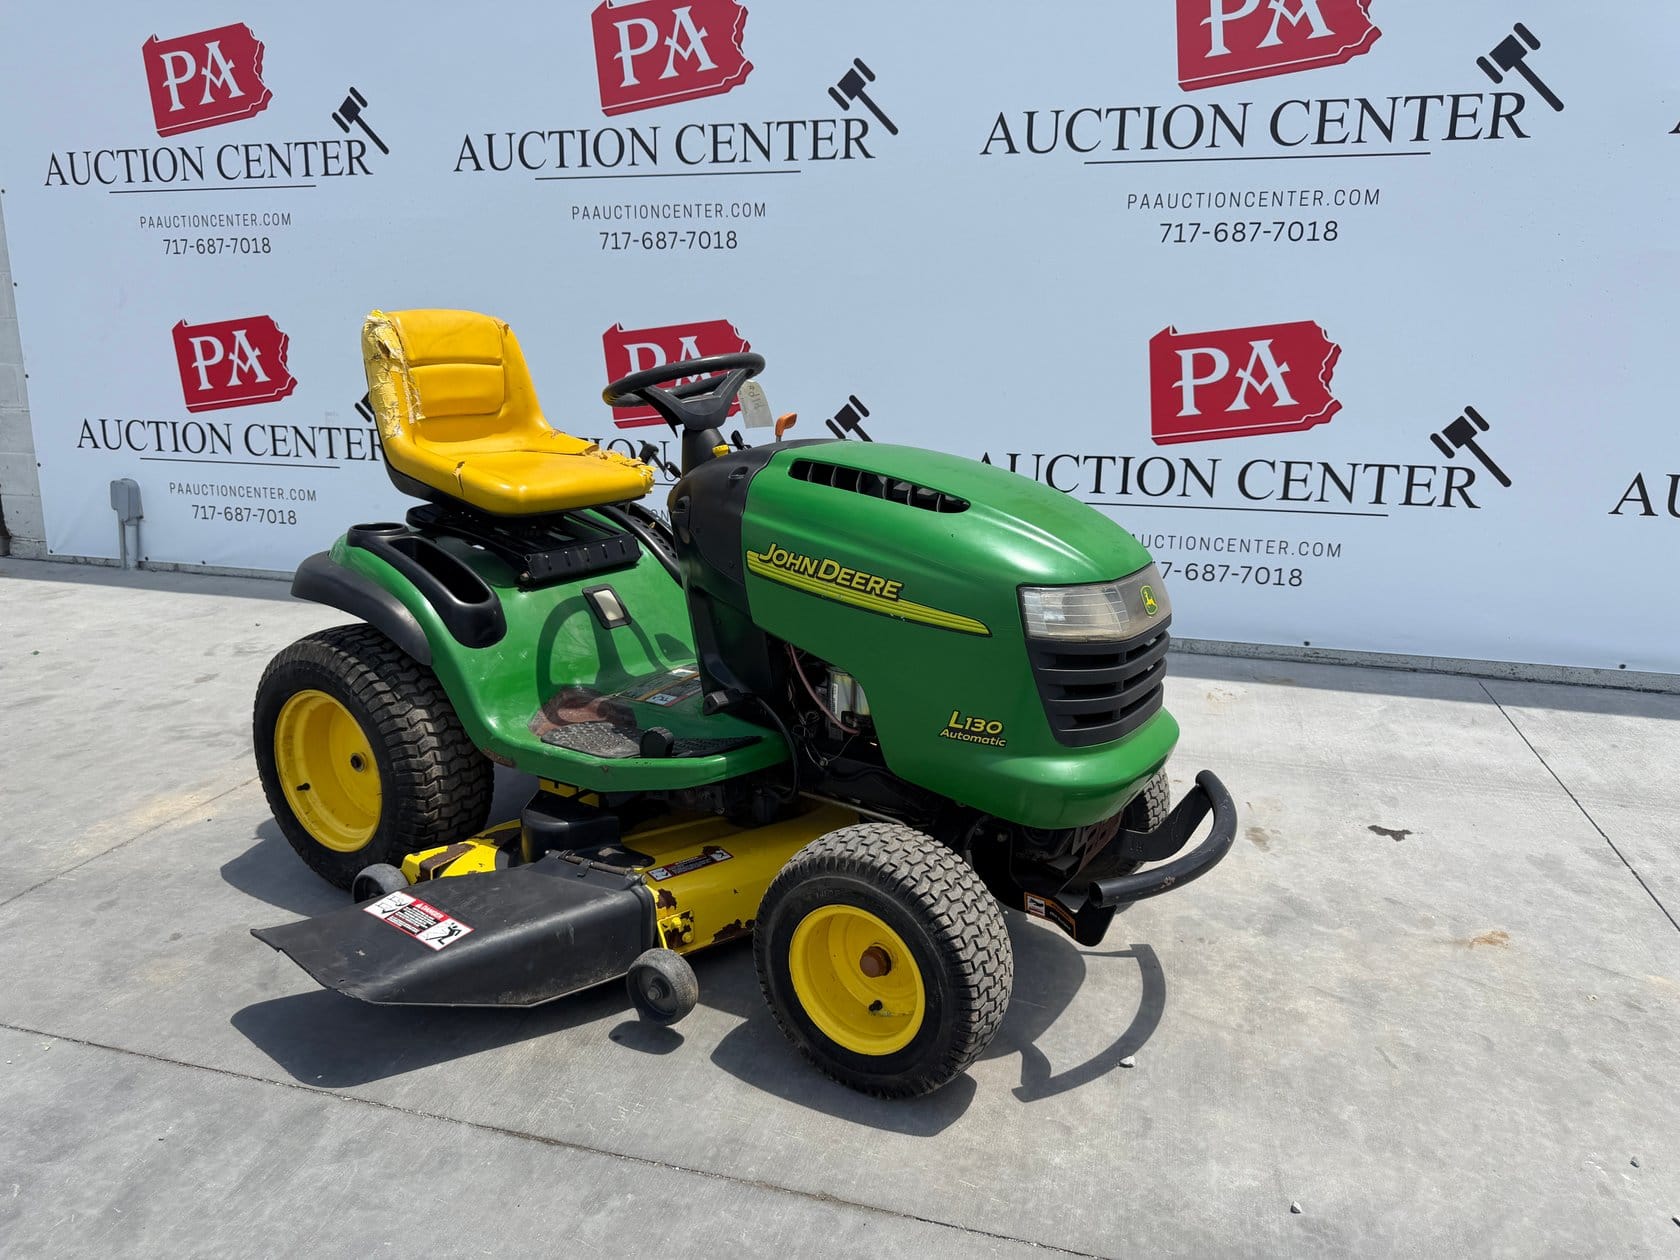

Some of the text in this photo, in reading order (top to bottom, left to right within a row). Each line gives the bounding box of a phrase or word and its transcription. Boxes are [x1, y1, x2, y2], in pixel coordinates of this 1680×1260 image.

[614, 6, 717, 87] PA
[160, 41, 244, 111] PA
[980, 92, 1530, 155] AUCTION CENTER
[454, 118, 875, 172] AUCTION CENTER
[45, 139, 373, 186] AUCTION CENTER
[572, 203, 765, 219] PAAUCTIONCENTER.COM
[1128, 189, 1379, 210] PAAUCTIONCENTER.COM
[140, 213, 290, 229] PAAUCTIONCENTER.COM
[1160, 221, 1338, 243] 717-687-7018
[163, 237, 271, 255] 717-687-7018
[600, 231, 737, 249] 717-687-7018
[190, 330, 270, 390] PA
[1173, 340, 1298, 416] PA
[77, 419, 232, 455] AUCTION
[170, 483, 317, 501] PAAUCTIONCENTER.COM
[981, 452, 1480, 509] UCTION CENTER
[192, 505, 297, 525] 717-687-7018
[1132, 534, 1342, 557] UCTIONCENTER.COM
[759, 544, 902, 599] JOHN DEERE
[1154, 561, 1303, 587] 7-687-7018
[948, 710, 1003, 734] L130
[940, 728, 1006, 747] Automatic
